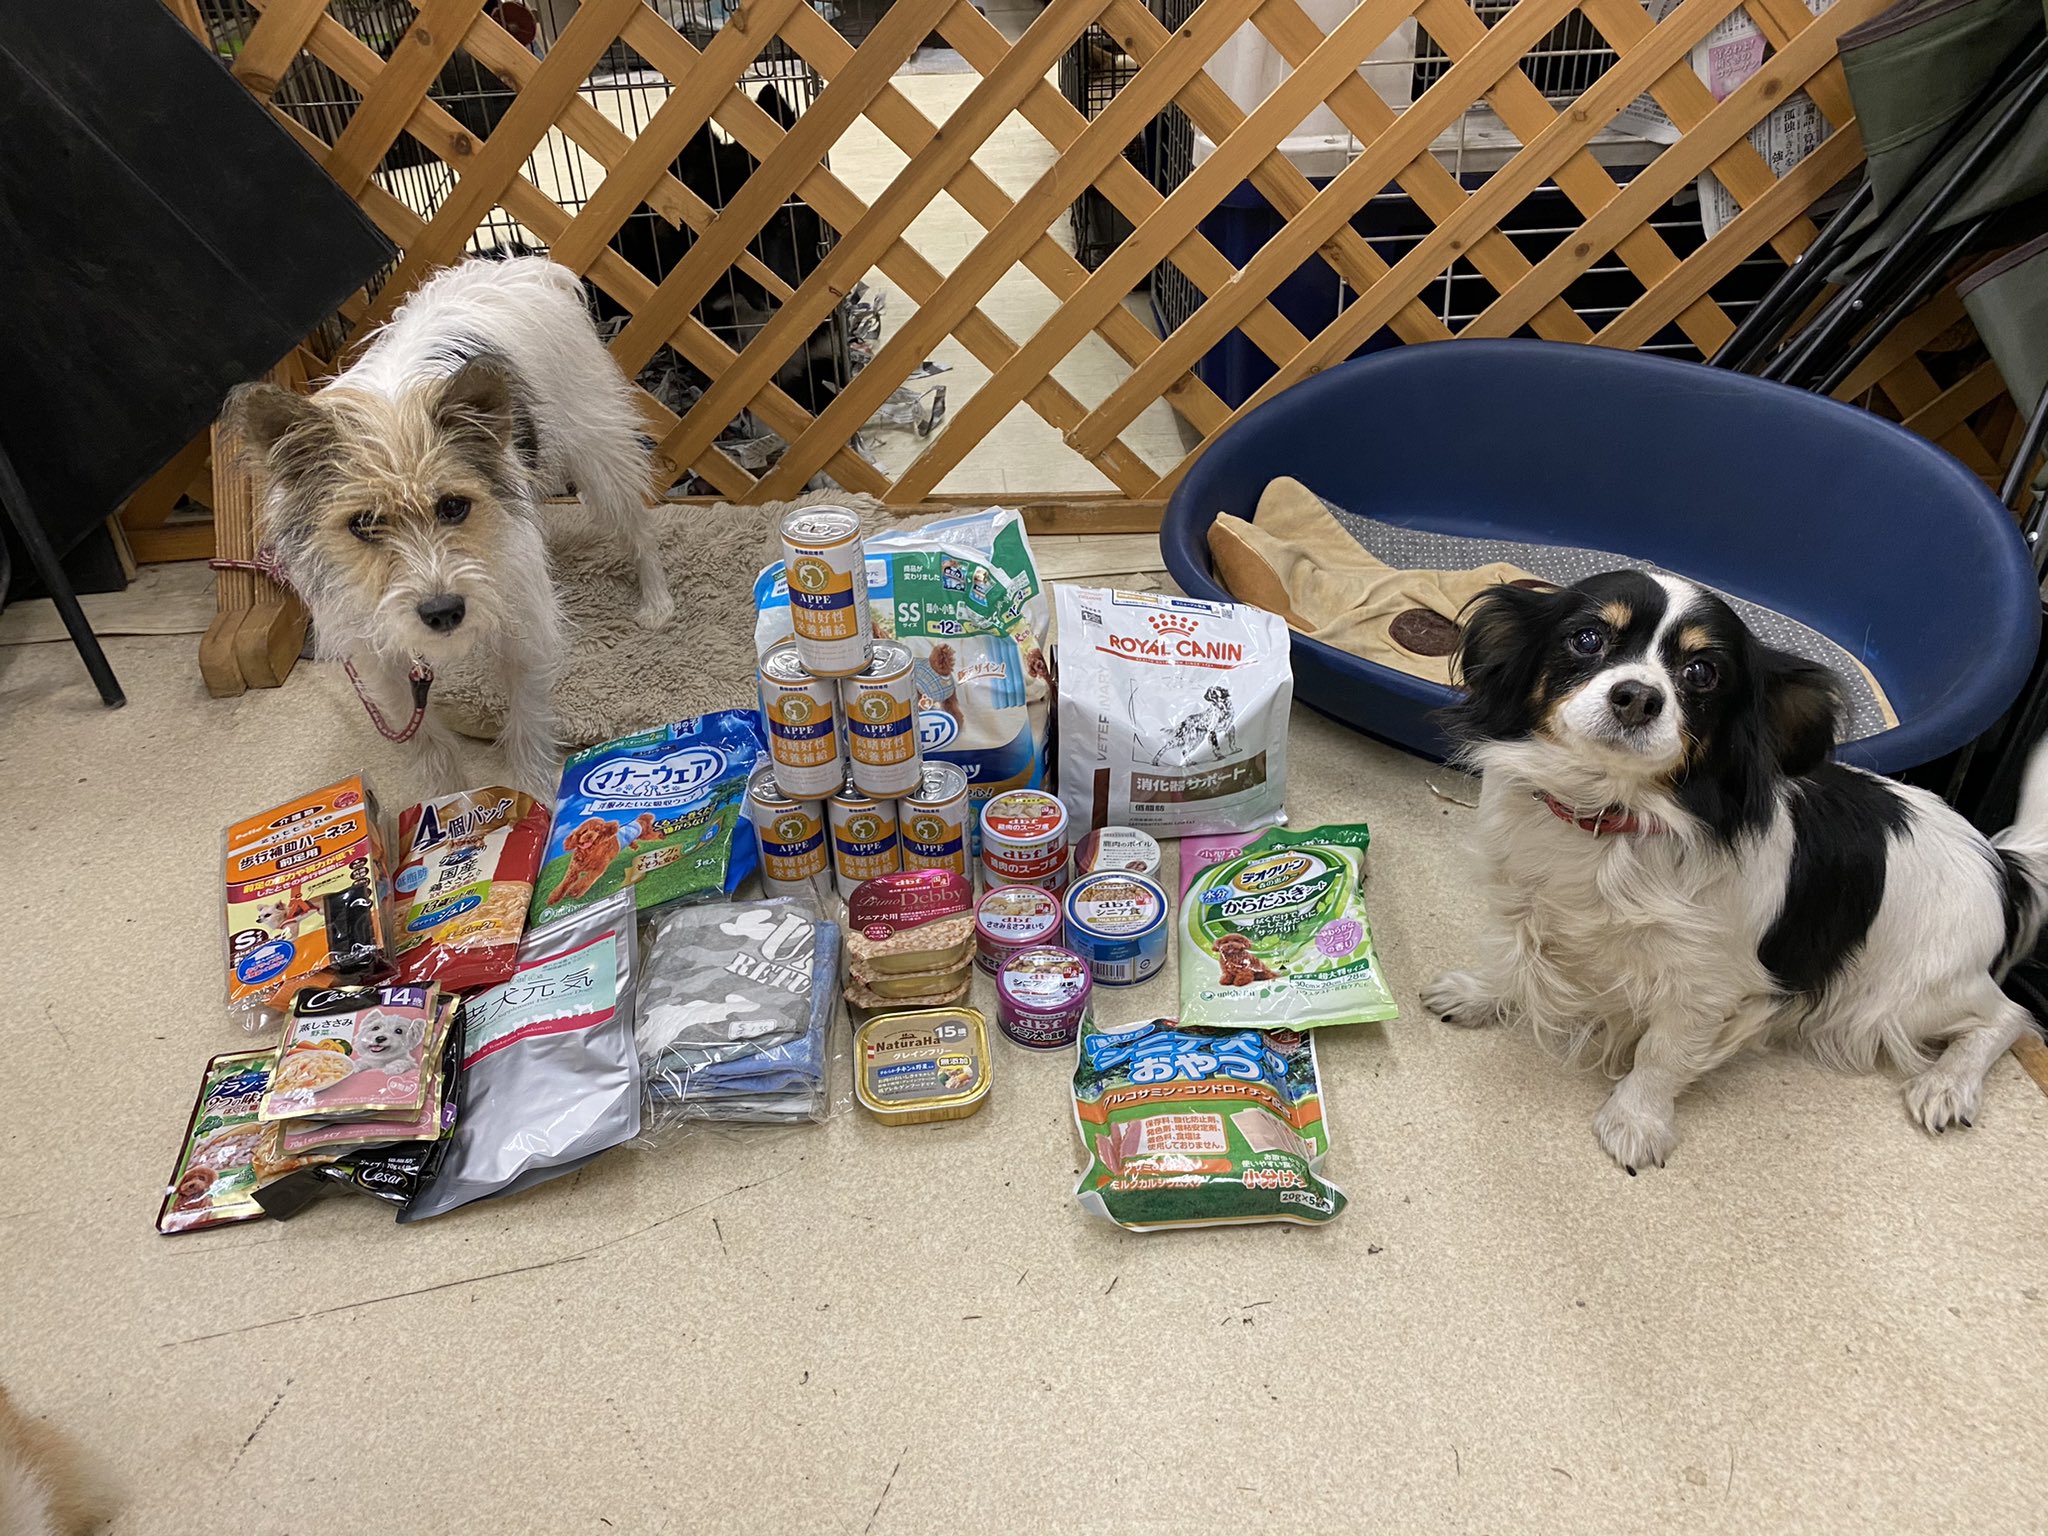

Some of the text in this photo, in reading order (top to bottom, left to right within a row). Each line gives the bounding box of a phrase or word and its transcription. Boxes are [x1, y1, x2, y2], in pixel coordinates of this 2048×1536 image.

[904, 573, 941, 581] 変わりました
[800, 593, 832, 604] APPE
[898, 602, 921, 622] SS
[939, 621, 955, 634] 12
[1109, 634, 1242, 662] ROYAL CANIN
[783, 725, 815, 735] APPE
[863, 724, 894, 733] APPE
[595, 758, 712, 789] マナーウェア
[1136, 767, 1246, 792] 消化器サポート
[1135, 804, 1165, 812] 低脂肪
[239, 820, 358, 871] 歩行補助ハーネス
[779, 841, 809, 852] APPE
[851, 841, 881, 852] APPE
[915, 843, 945, 852] APPE
[279, 847, 319, 868] 前足用
[1002, 849, 1043, 860] dbf
[1200, 849, 1240, 859] 小型犬
[637, 854, 680, 871] そそうに安心
[397, 866, 428, 888] 低脂肪
[439, 861, 479, 882] 国産
[1241, 858, 1306, 884] デオクリーン
[895, 877, 923, 886] dbf
[900, 887, 964, 907] Debby
[1204, 888, 1229, 899] 水分
[1221, 880, 1328, 916] からだふきシート
[1098, 900, 1135, 908] dbf
[857, 913, 898, 921] シニア犬用
[1095, 907, 1141, 917] シニア食
[1256, 911, 1299, 925] 拭くだけで
[1237, 910, 1318, 932] シャワーしたみたいに
[235, 930, 257, 950] S
[1323, 928, 1356, 945] ソープ
[1326, 939, 1354, 954] の香り
[298, 1018, 354, 1034] 蒸しささみ
[1019, 1019, 1063, 1030] dbf
[876, 1036, 941, 1052] NaturaHa
[892, 1048, 953, 1060] グレインフリー
[1130, 1052, 1262, 1081] おやつ
[1147, 1133, 1202, 1144] 着色料、食塩は
[1147, 1141, 1224, 1151] 使用しておりません。
[361, 1166, 405, 1185] Cesar
